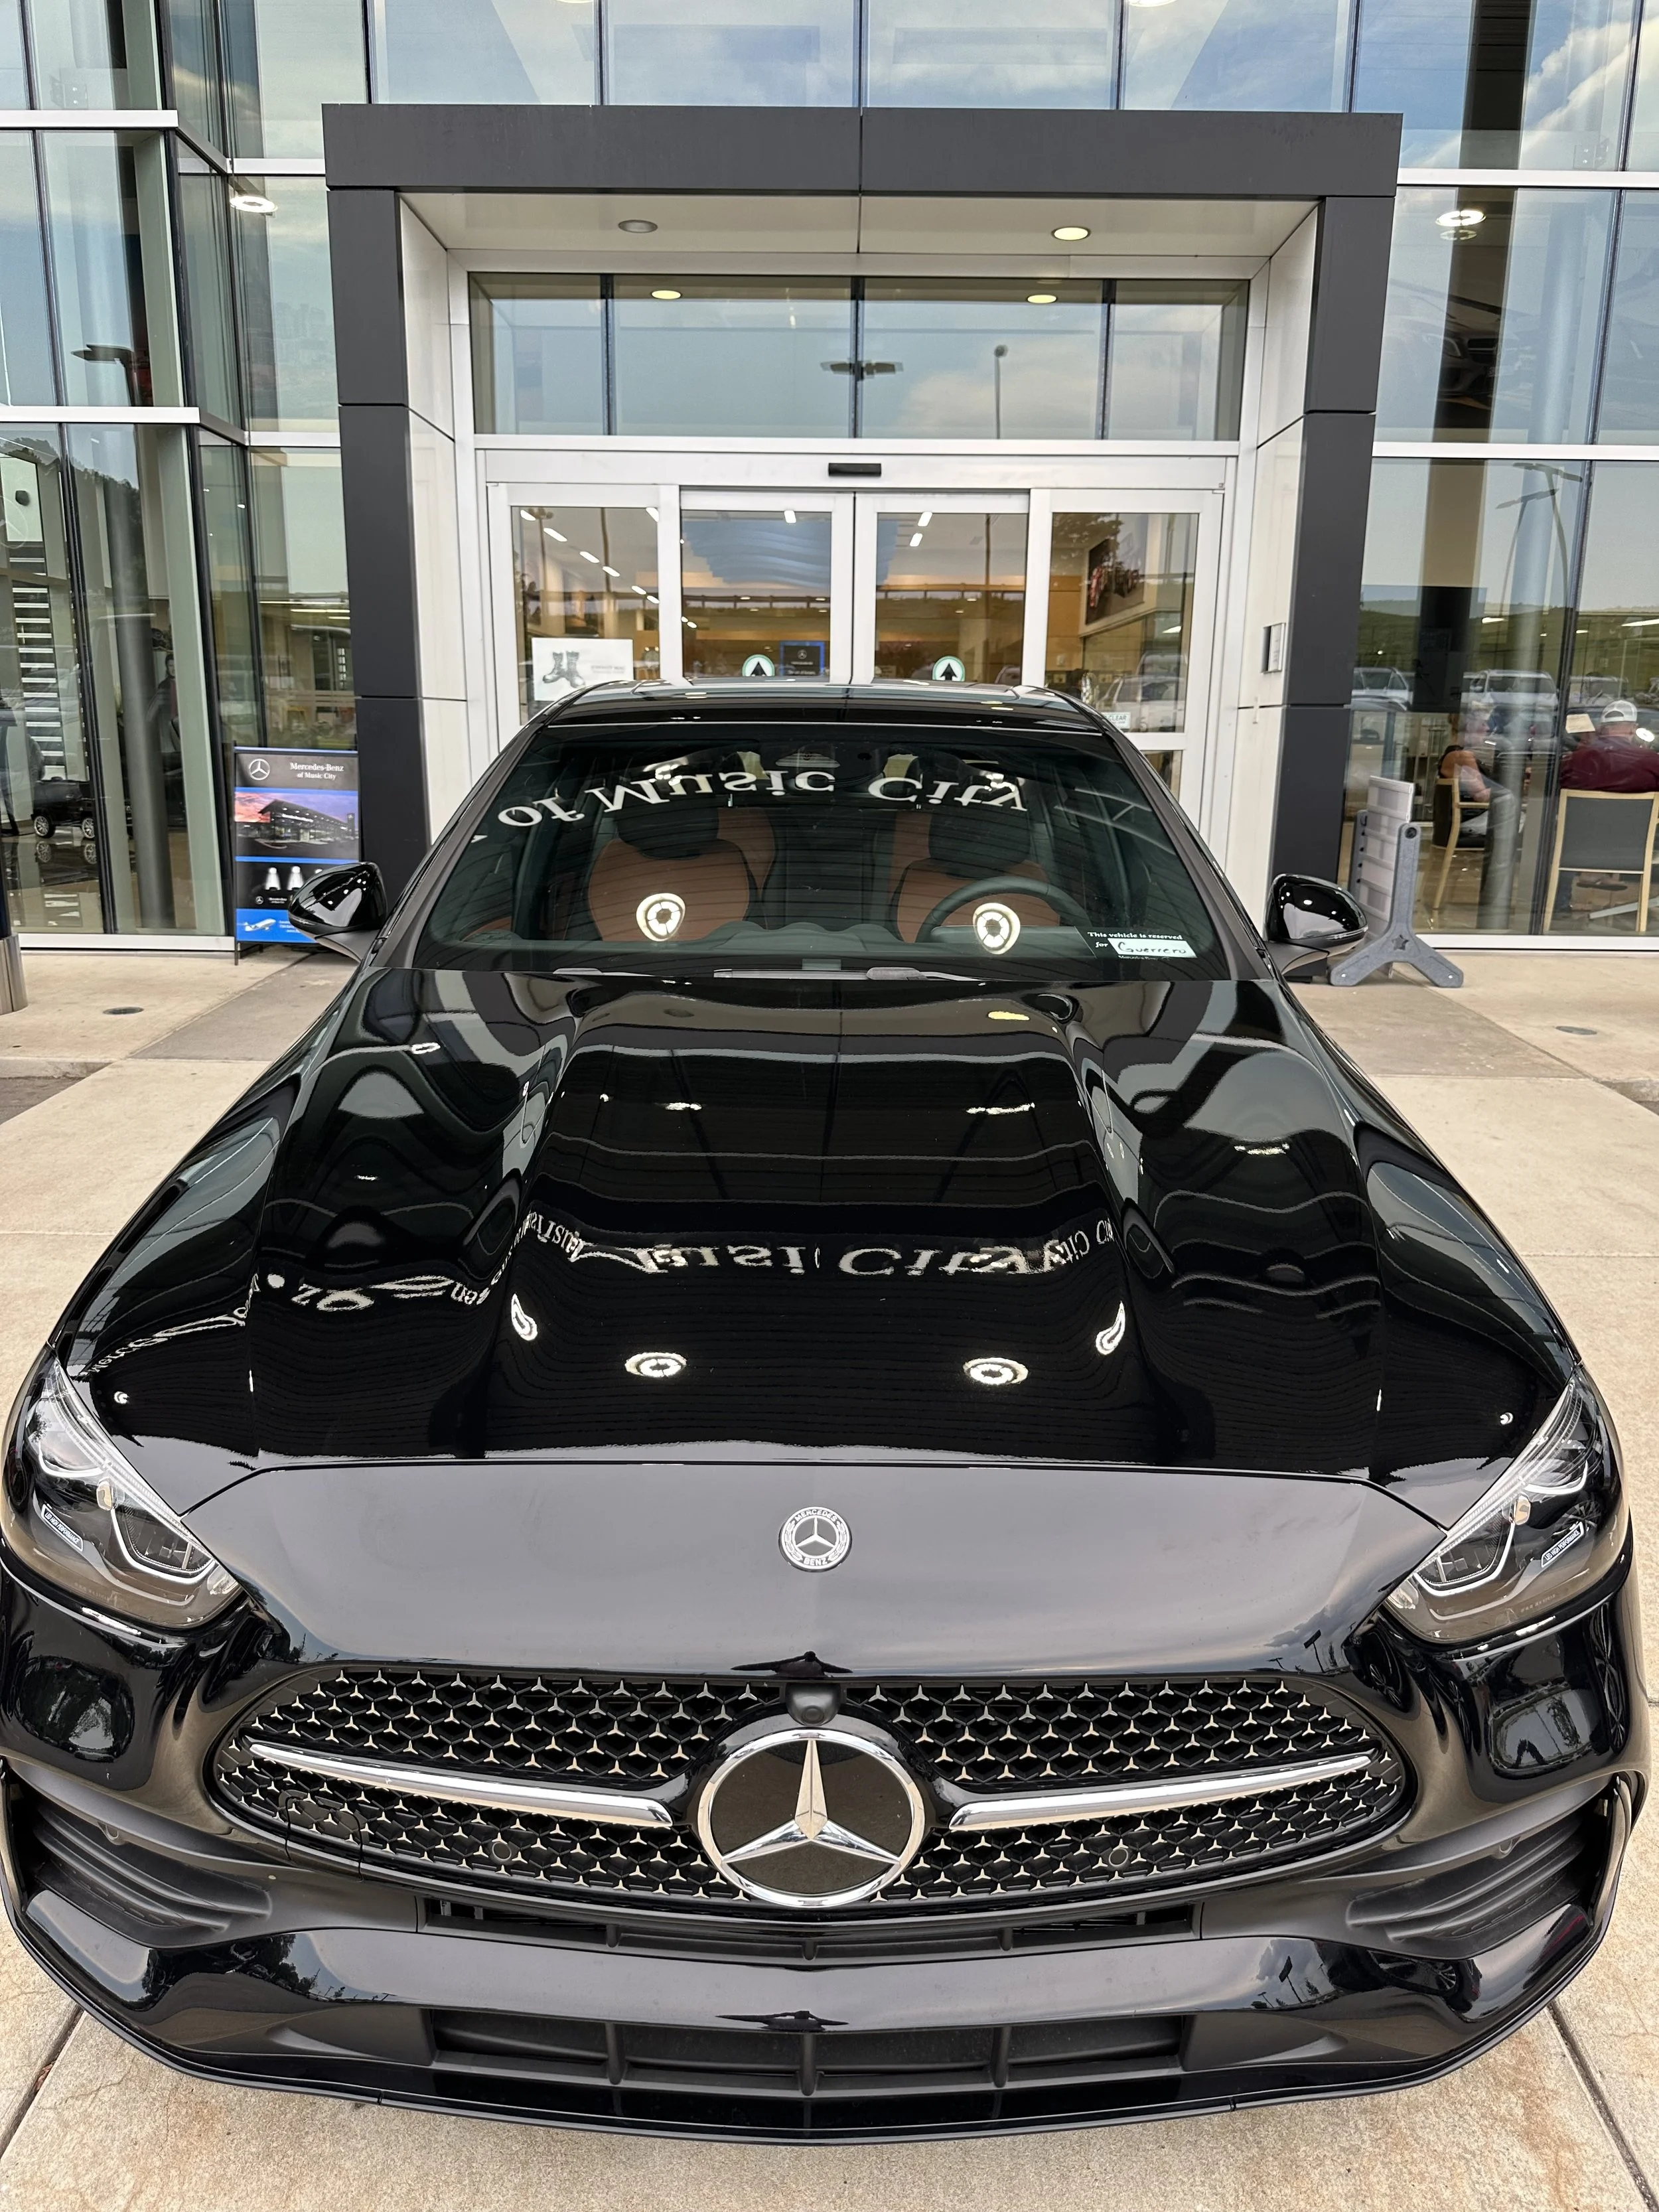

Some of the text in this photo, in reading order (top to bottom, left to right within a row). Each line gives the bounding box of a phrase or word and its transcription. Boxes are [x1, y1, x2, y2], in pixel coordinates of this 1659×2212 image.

[289, 762, 344, 772] Mercedes-Benz
[323, 773, 337, 781] City
[1118, 941, 1187, 954] Guerrero
[794, 1509, 837, 1523] MERCEDES
[56, 1523, 80, 1545] PERFORMANCE
[1557, 1529, 1581, 1550] PERFORMANCE
[803, 1557, 828, 1566] BENZ
